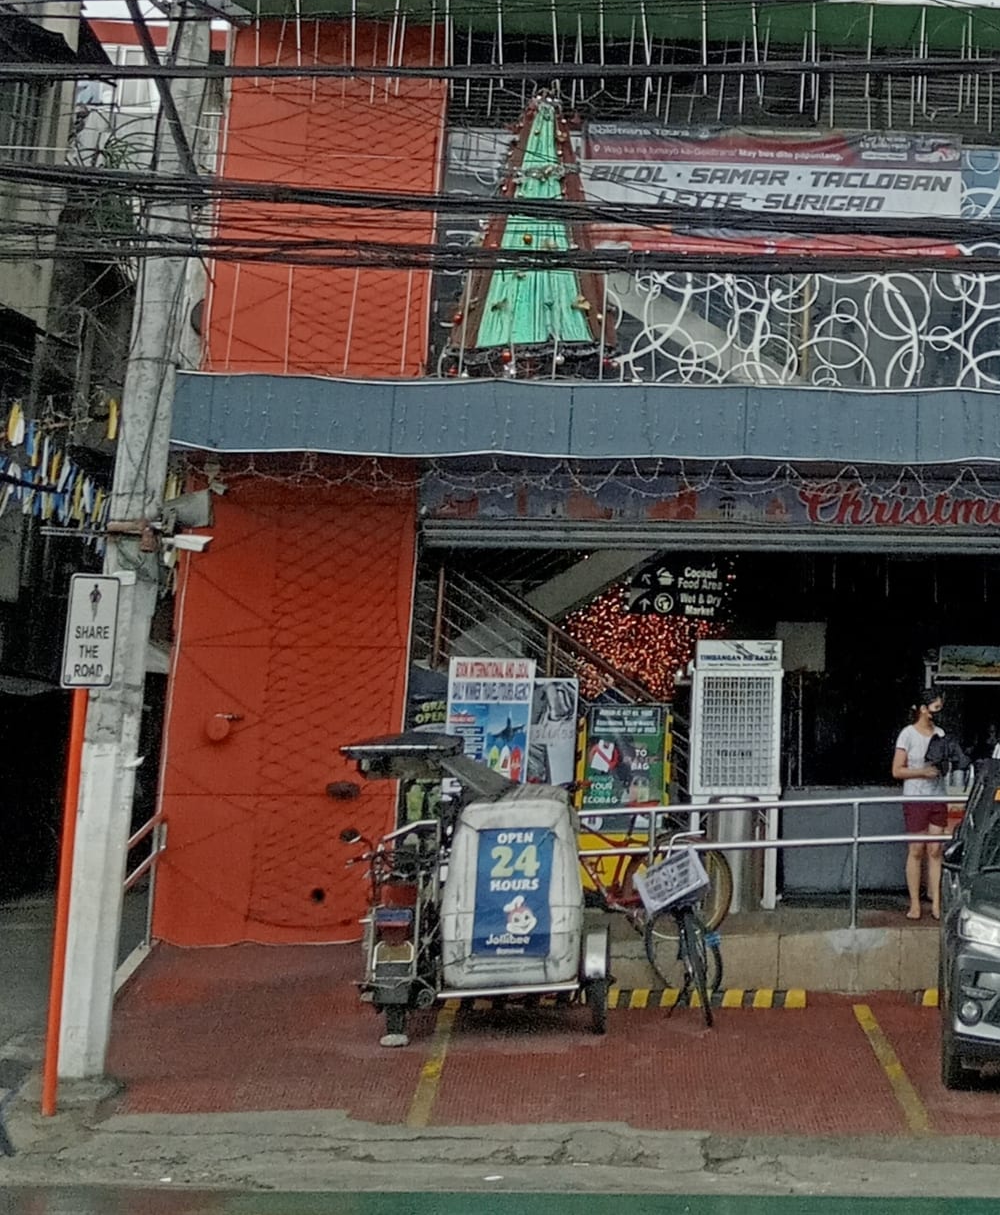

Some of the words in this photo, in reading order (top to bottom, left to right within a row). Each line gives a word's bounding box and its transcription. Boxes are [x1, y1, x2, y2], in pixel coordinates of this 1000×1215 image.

[589, 165, 668, 183] BICOL
[688, 167, 790, 186] SAMAR
[810, 171, 953, 192] TACLOBAN
[763, 193, 886, 213] SURIGAO
[677, 576, 700, 590] Food
[701, 579, 723, 590] Area
[706, 594, 722, 608] Dry
[685, 604, 715, 617] Market
[74, 625, 110, 639] SHARE
[79, 644, 99, 659] THE
[73, 663, 104, 678] ROAD
[631, 762, 650, 771] BAG
[497, 832, 534, 844] OPEN
[490, 844, 541, 878] 24
[489, 878, 540, 892] HOURS
[486, 933, 531, 946] Jollibee
